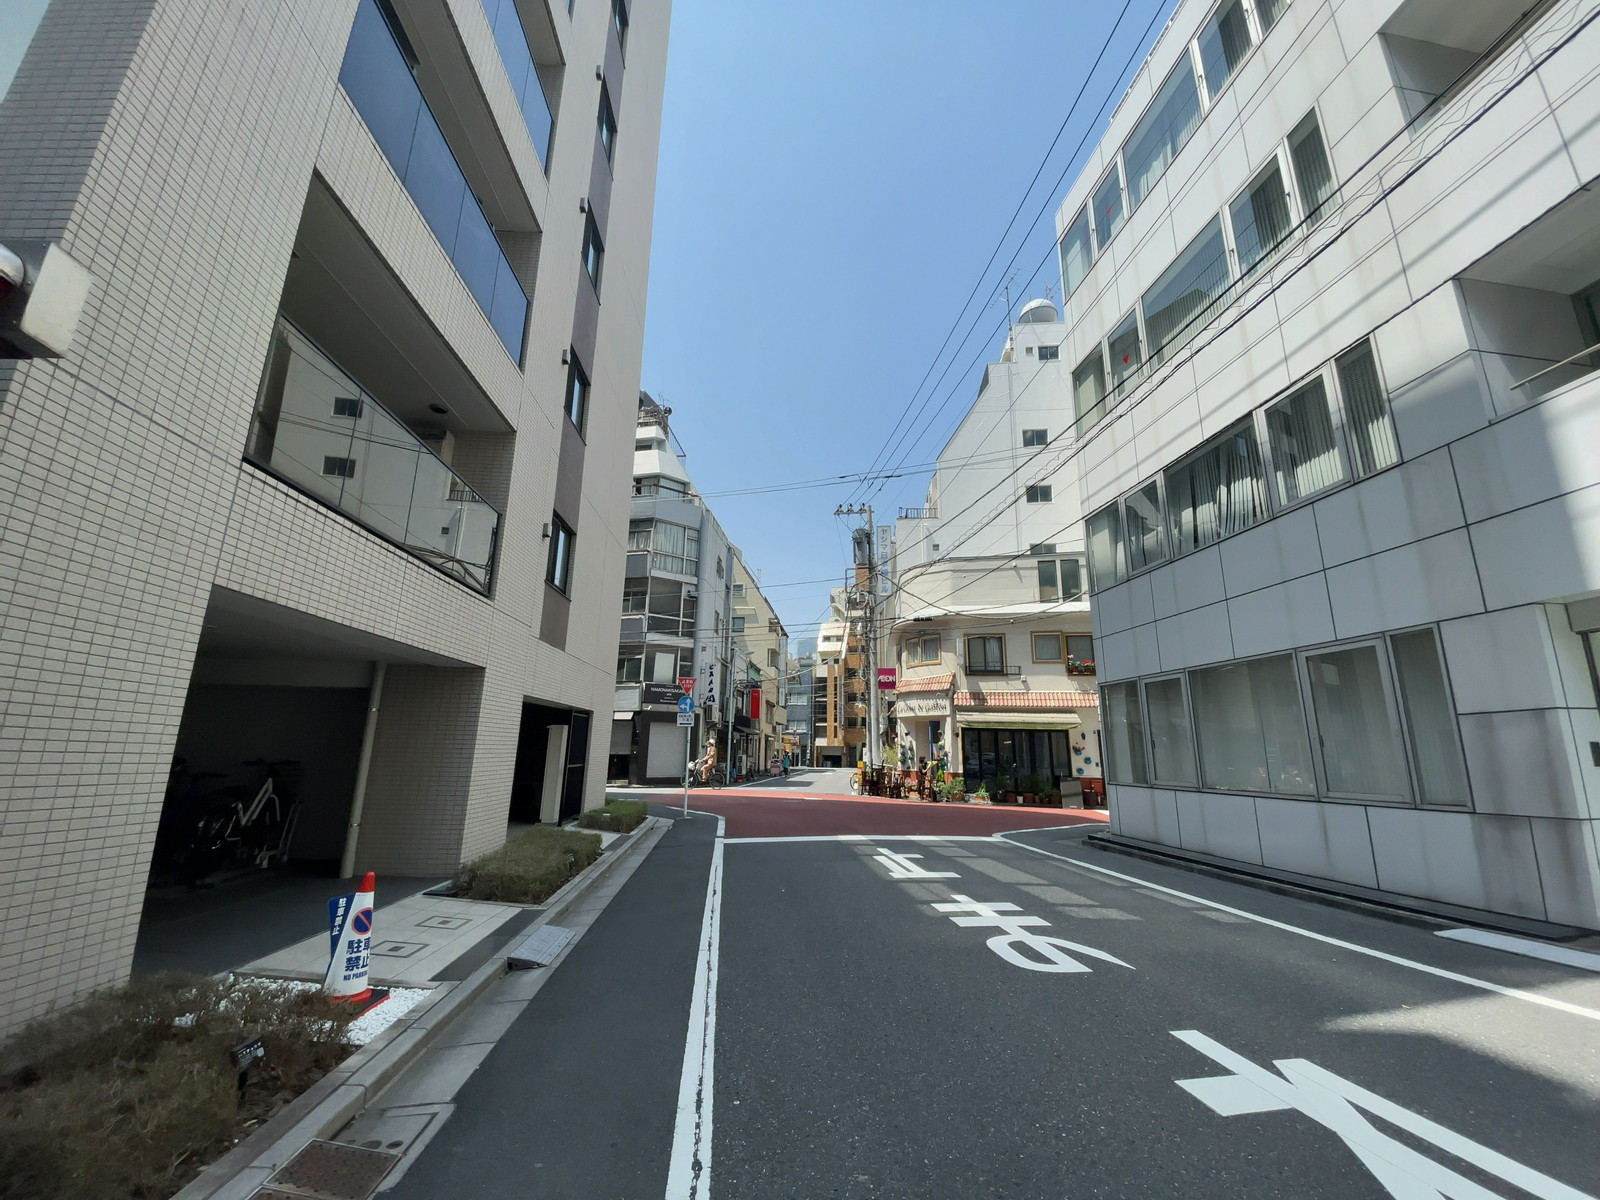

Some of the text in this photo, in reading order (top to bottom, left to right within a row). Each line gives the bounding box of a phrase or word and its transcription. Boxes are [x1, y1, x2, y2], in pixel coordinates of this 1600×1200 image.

[332, 897, 347, 936] 駐車禁止
[346, 937, 371, 955] 駐車
[345, 955, 369, 972] 禁止
[352, 970, 368, 980] PARKIN
